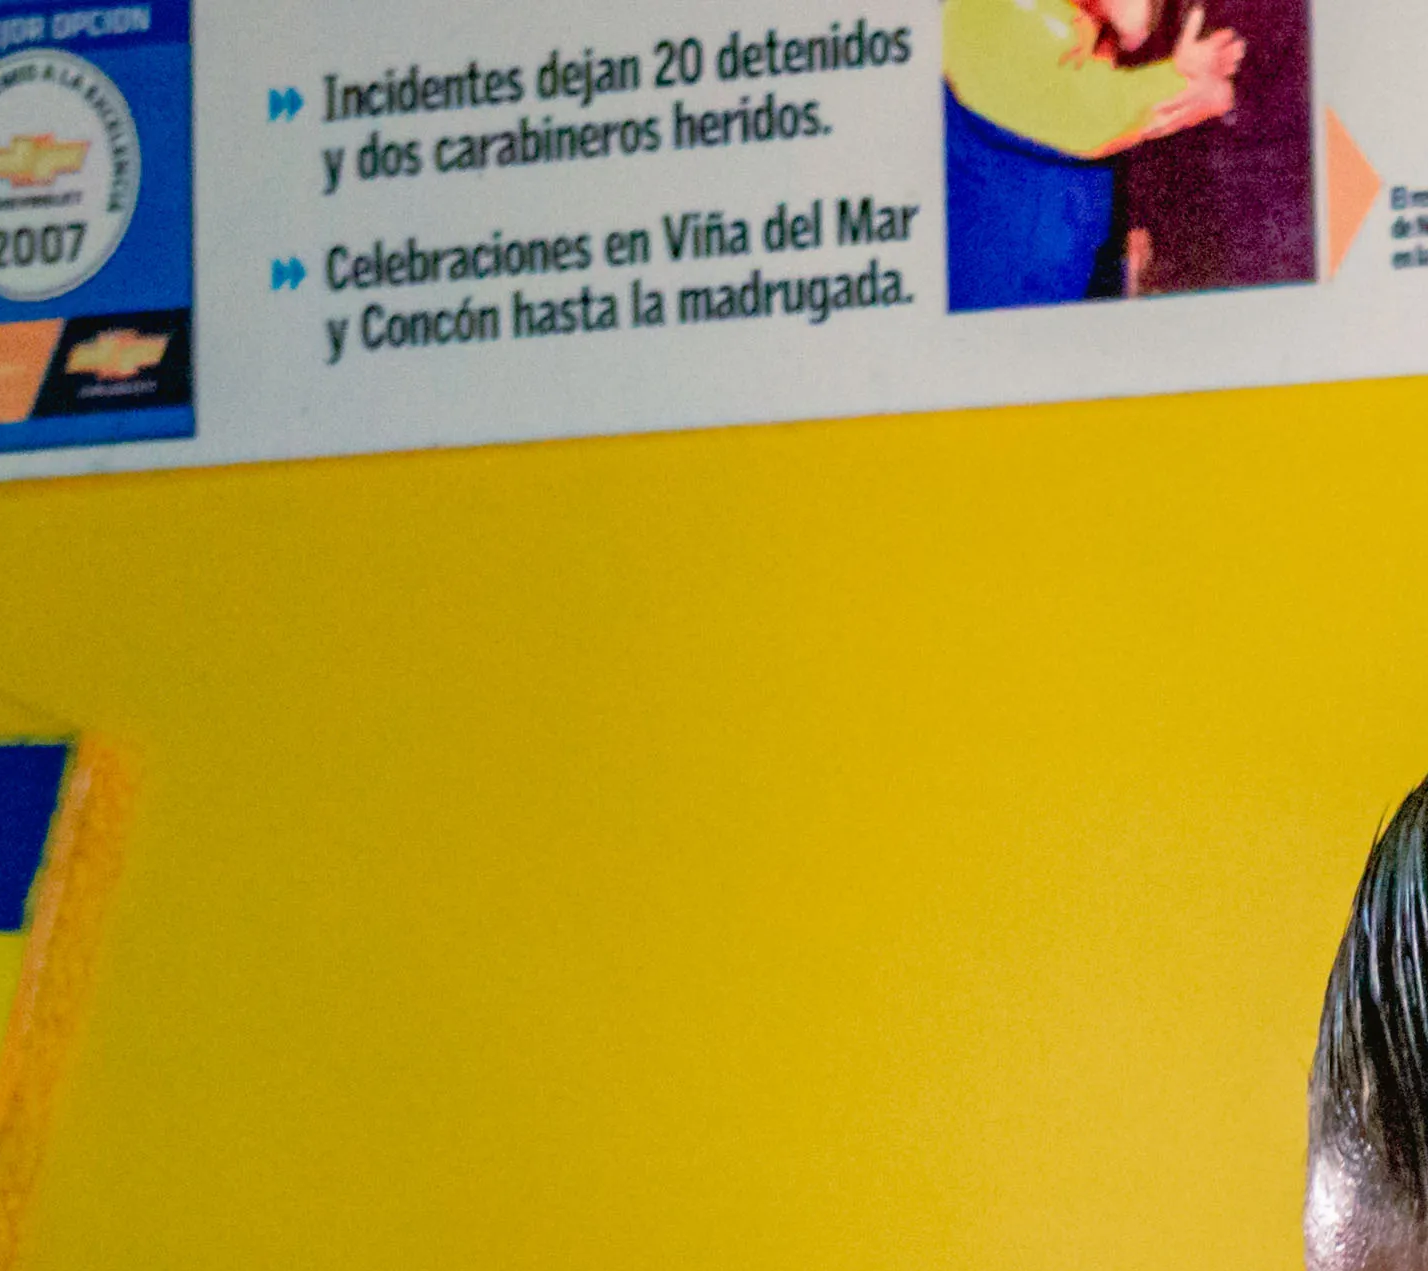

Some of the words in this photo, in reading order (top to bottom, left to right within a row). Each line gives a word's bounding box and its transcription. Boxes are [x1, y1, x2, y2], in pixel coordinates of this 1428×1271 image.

[322, 59, 524, 122] Incidentes
[537, 48, 640, 107] dejan
[653, 37, 703, 88] 20
[717, 17, 912, 82] detenidos
[322, 147, 344, 196] y
[358, 130, 422, 180] dos
[434, 115, 661, 174] carabineros
[674, 93, 832, 150] heridos.
[326, 230, 592, 291] Celebraciones
[605, 228, 651, 267] en
[663, 211, 749, 261] Viña
[764, 200, 823, 252] del
[837, 197, 919, 246] Mar
[326, 318, 348, 366] y
[361, 295, 501, 352] Concón
[512, 285, 619, 338] hasta
[631, 278, 665, 328] la
[678, 259, 914, 326] madrugada.
